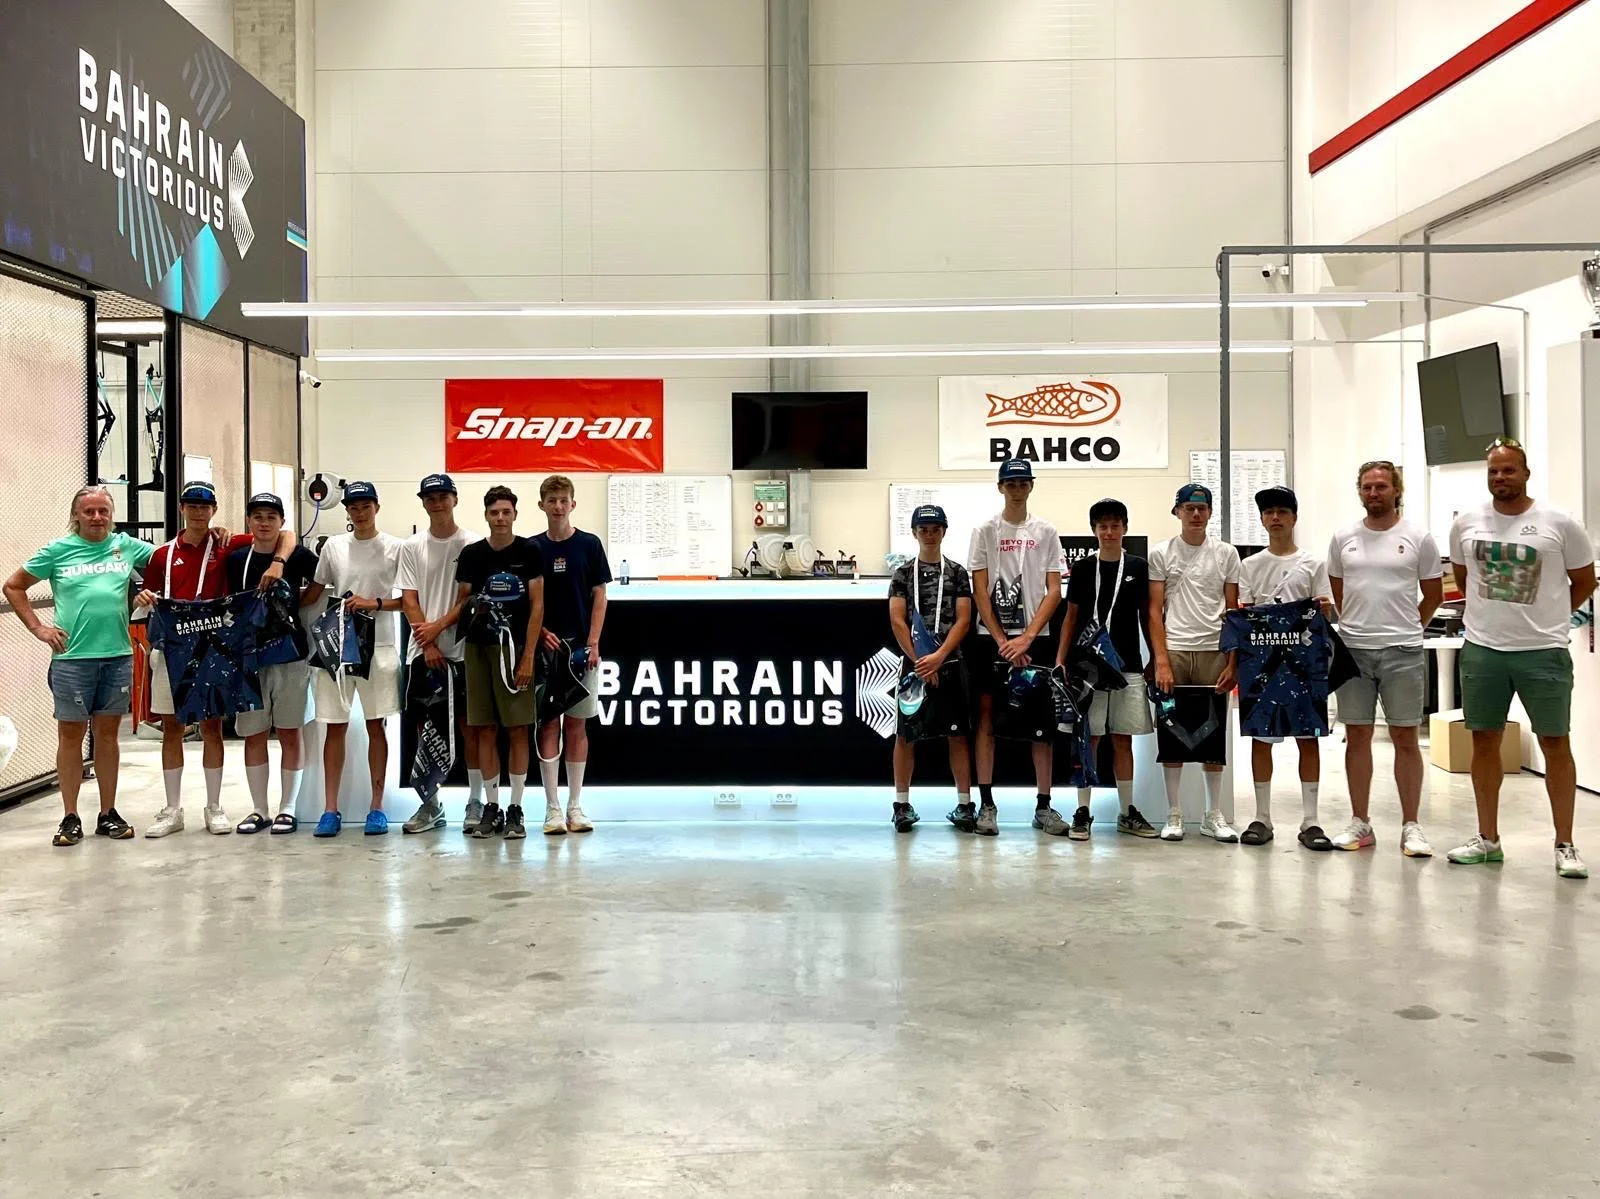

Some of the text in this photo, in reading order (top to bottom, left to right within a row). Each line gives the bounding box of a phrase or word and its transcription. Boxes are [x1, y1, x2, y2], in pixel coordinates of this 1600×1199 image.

[79, 48, 223, 190] BAHRAIN
[79, 117, 224, 231] VICTORIOUS
[990, 437, 1120, 462] BAHCO
[176, 616, 221, 630] BAHRAIN
[177, 623, 222, 635] VICTORIOUS
[1250, 632, 1299, 640] BAHRAIN
[598, 660, 843, 695] BAHRAIN
[598, 700, 843, 726] VICTORIOUS
[422, 729, 448, 776] ICTORIOU
